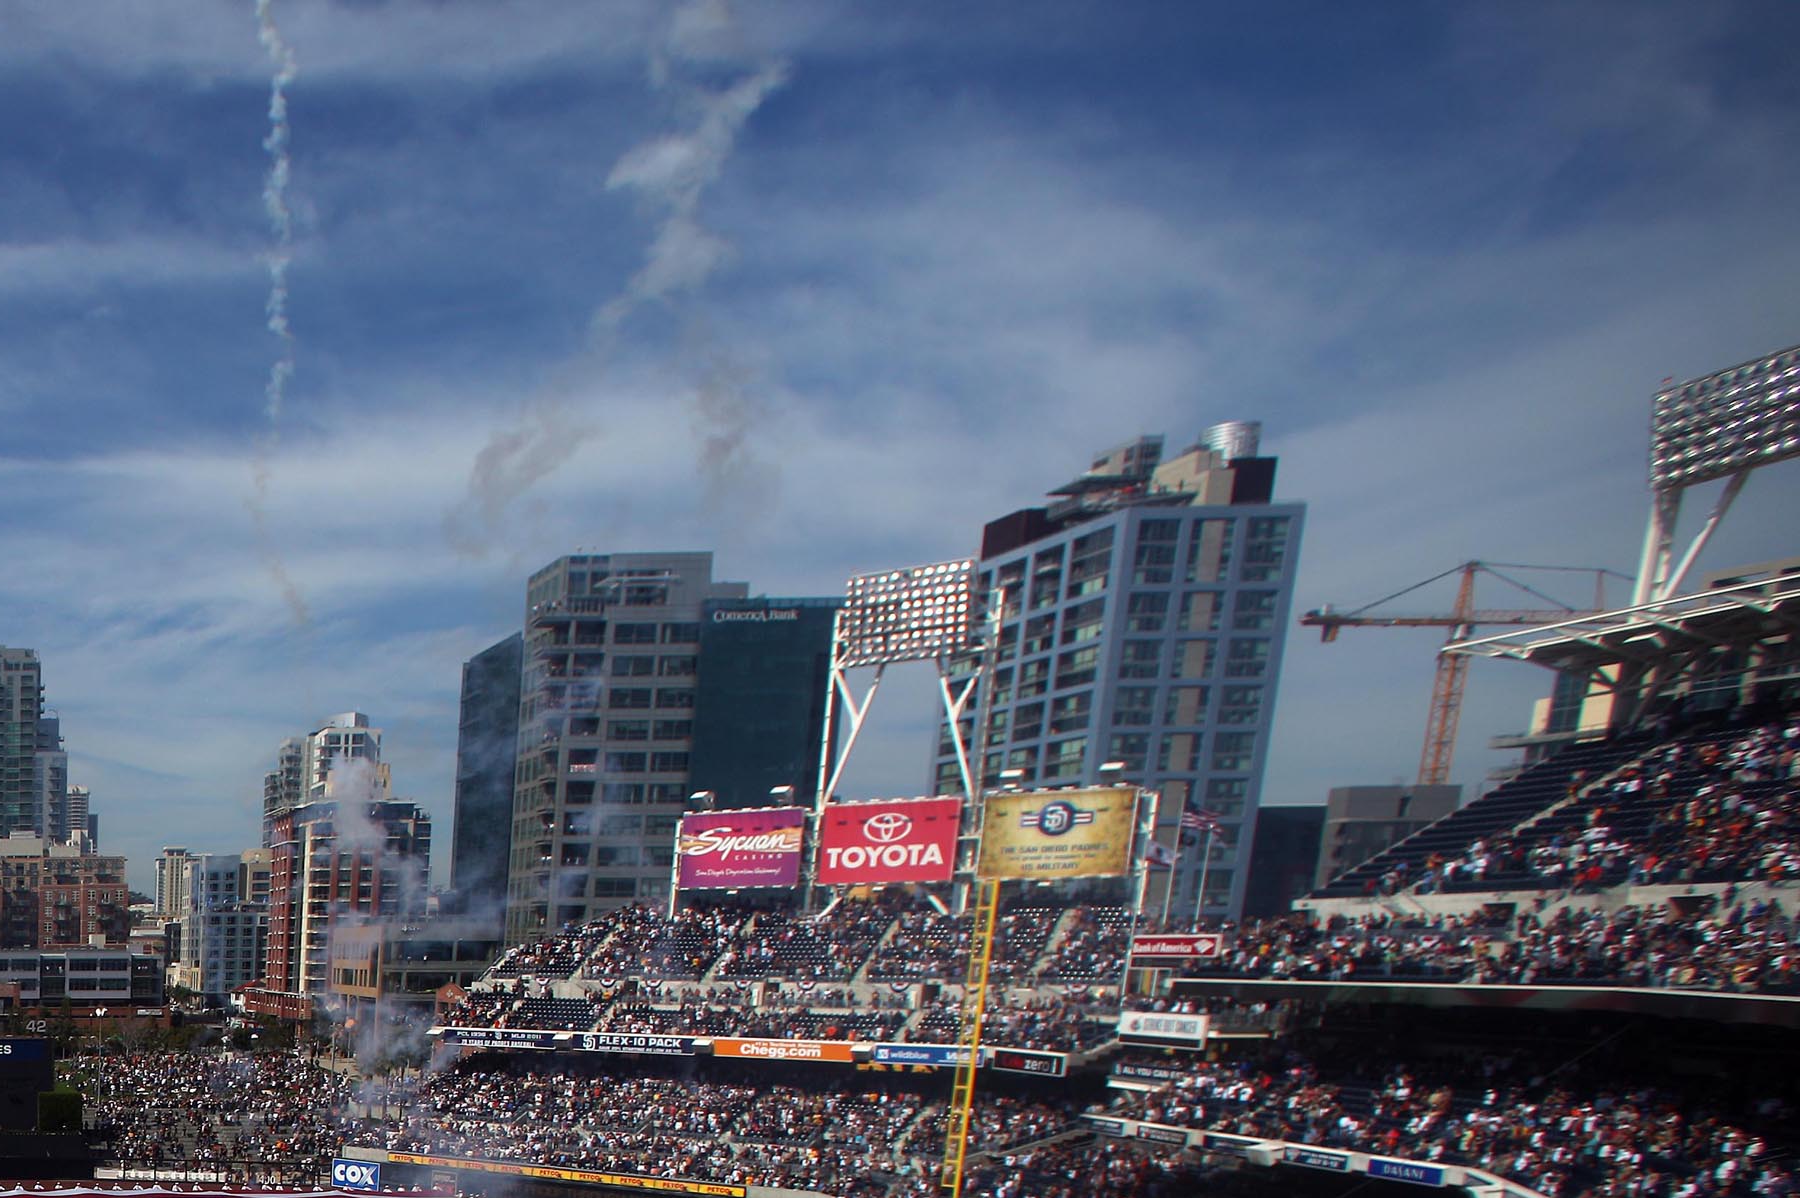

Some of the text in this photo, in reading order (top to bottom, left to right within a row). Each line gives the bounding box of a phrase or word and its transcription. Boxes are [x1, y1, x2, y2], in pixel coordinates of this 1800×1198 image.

[687, 827, 800, 861] Sycuan
[734, 853, 783, 861] CASINO
[827, 843, 944, 869] TOYOTA
[1160, 943, 1193, 954] America
[26, 1019, 47, 1033] 42
[599, 1035, 646, 1046] FLEX-10
[648, 1037, 682, 1047] PACK
[740, 1043, 821, 1058] Chegg.com
[334, 1163, 376, 1186] COX
[579, 1173, 600, 1182] PETCO
[620, 1177, 642, 1185] PETCO
[707, 1186, 729, 1195] PETCO
